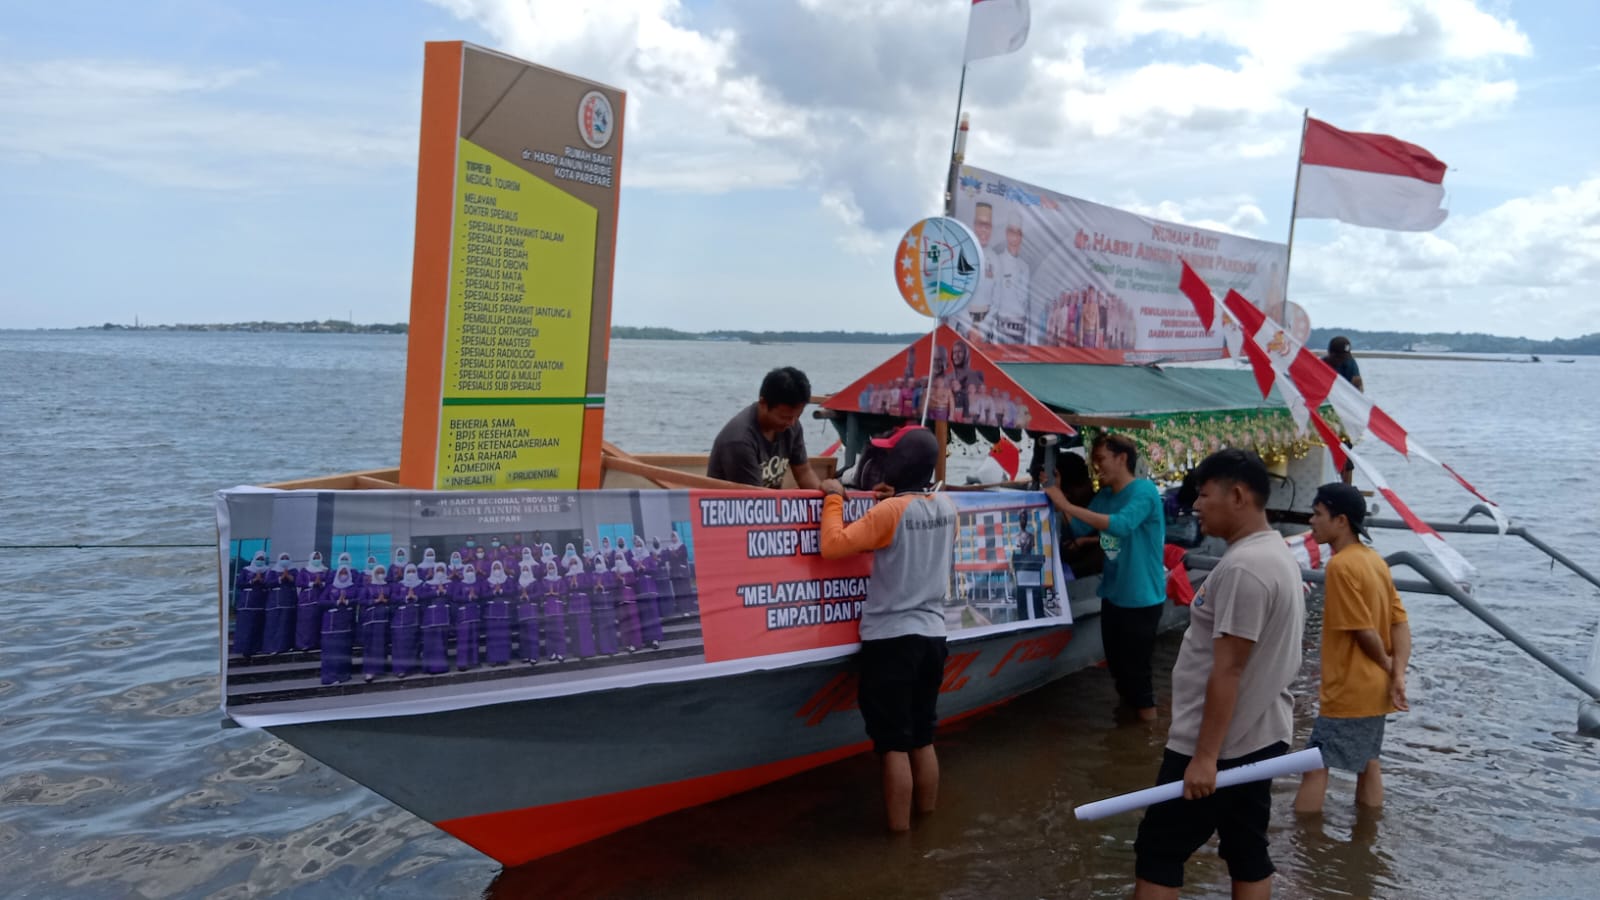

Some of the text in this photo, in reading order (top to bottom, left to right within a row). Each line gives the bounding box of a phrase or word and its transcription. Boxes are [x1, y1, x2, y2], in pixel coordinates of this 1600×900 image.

[565, 146, 613, 165] RUMAH SAKIT
[534, 151, 558, 165] HASRI
[560, 157, 583, 169] AINUN
[583, 162, 612, 176] HABIBIE
[466, 173, 521, 192] MEDICAL TOURISM
[555, 167, 612, 188] KOTA PAREPARE
[464, 192, 497, 207] MELAYANI
[464, 204, 518, 222] DOKTER SPESIALIS
[469, 220, 564, 242] SPESIALIS PENYAKIT DALAM
[468, 232, 525, 248] SPESIALIS ANAK
[467, 243, 528, 259] SPESIALIS BEDAH
[466, 255, 501, 268] SPESIALIS
[466, 266, 522, 281] SPESIALIS MATA
[465, 278, 500, 291] SPESIALIS
[464, 290, 524, 303] SPESIALIS SARAF
[463, 301, 498, 313] SPESIALIS
[500, 304, 534, 315] PENYAKIT
[535, 306, 566, 318] JANTUNG
[464, 313, 533, 326] PEMBULUH DARAH
[462, 324, 540, 337] SPESIALIS ORTHOPEDI
[462, 335, 531, 348] SPESIALIS ANASTESI
[461, 347, 536, 359] SPESIALIS RADIOLOGI
[460, 358, 564, 370] SPESIALIS PATOLOGI ANATOMI
[459, 370, 493, 380] SPESIALIS
[495, 370, 510, 380] GIGI
[518, 371, 541, 380] MULUT
[458, 381, 542, 391] SPESIALIS SUB SPESIALIS
[491, 418, 516, 428] SAMA
[456, 428, 530, 440] BPJS KESEHATAN
[455, 441, 476, 451] BPJS
[454, 450, 517, 462] JASA RAHARJA
[453, 462, 501, 474] ADMEDIKA
[451, 469, 559, 486] INHEALTH PRUDENTIAL
[477, 496, 520, 505] REGIONAL
[700, 499, 780, 526] TERUNGGUL
[781, 498, 808, 523] DAN
[748, 530, 798, 557] KONSEP
[768, 604, 821, 629] EMPATI
[824, 601, 851, 622] DAN
